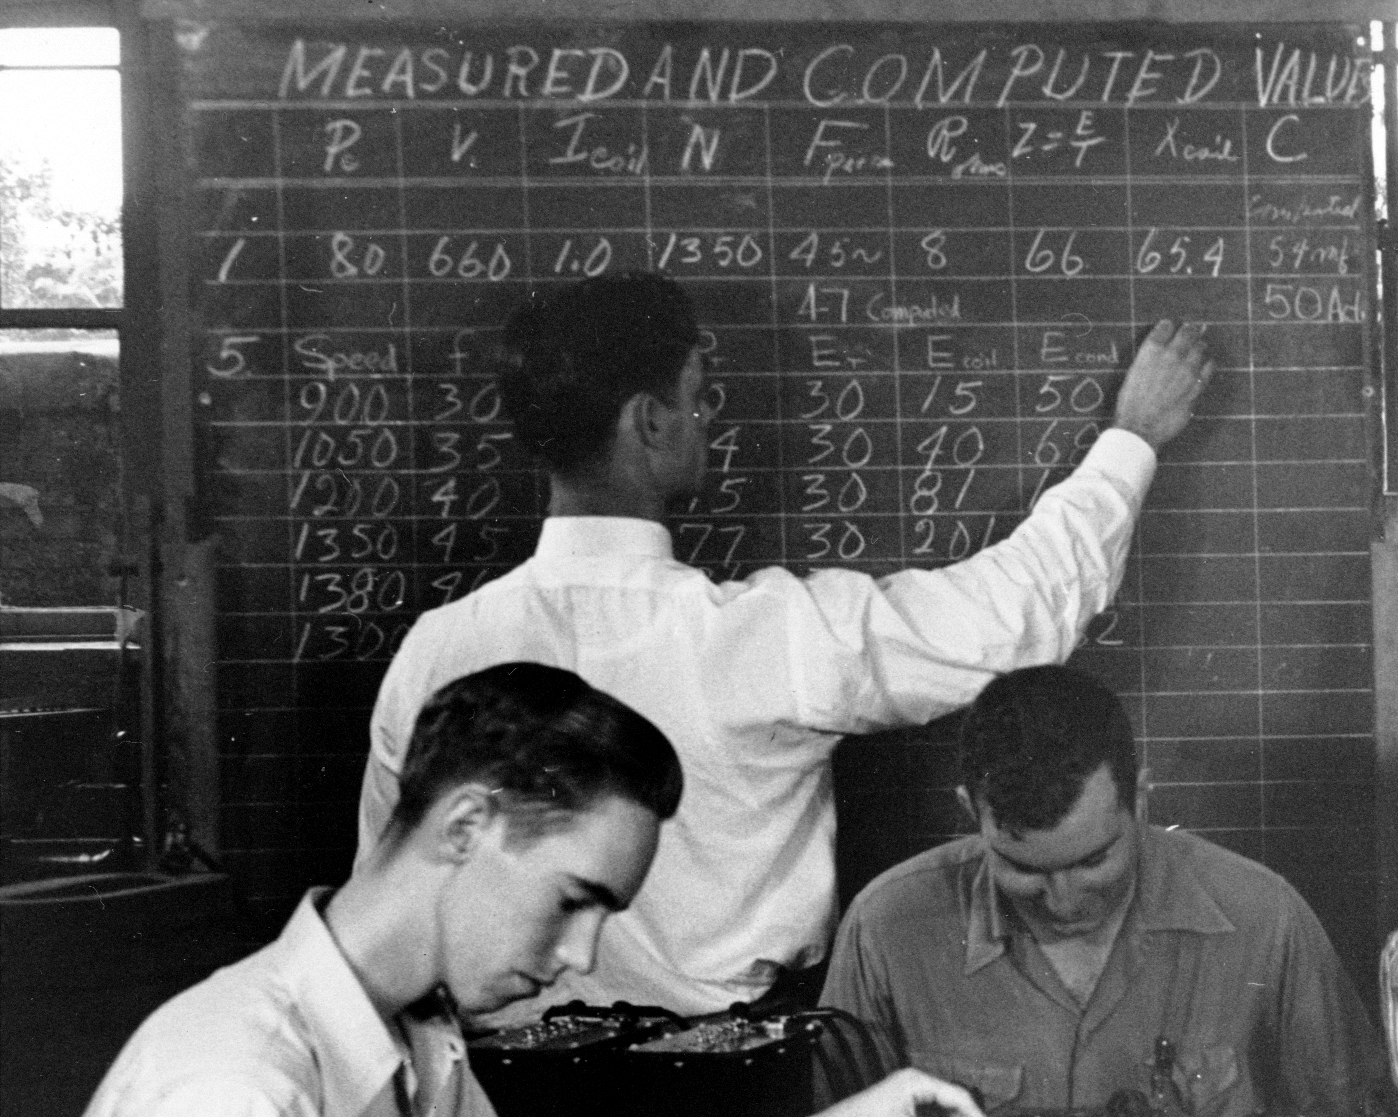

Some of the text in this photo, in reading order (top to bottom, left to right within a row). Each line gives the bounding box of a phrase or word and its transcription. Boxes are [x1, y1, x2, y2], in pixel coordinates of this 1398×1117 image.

[278, 40, 629, 100] MEASURED
[644, 46, 777, 101] AND
[803, 45, 1221, 108] COMPUTED
[682, 123, 721, 170] N
[1266, 114, 1308, 163] C
[218, 238, 246, 283] 1
[331, 232, 385, 278] 80
[429, 236, 511, 282] 660
[554, 238, 613, 278] 1.0
[658, 233, 763, 269] 1350
[920, 229, 948, 270] 8
[1025, 228, 1084, 276] 66
[1137, 228, 1224, 277] 65.4
[798, 283, 850, 323] 47
[1265, 284, 1322, 320] 50
[207, 336, 261, 379] 5
[295, 334, 397, 381] Speed
[301, 376, 1104, 426] 900 30 30 15 50
[294, 428, 399, 469] 1050
[432, 432, 514, 473] 35
[807, 424, 872, 468] 30
[917, 426, 984, 475] 40
[289, 472, 400, 518] 1200
[431, 477, 502, 519] 40
[803, 472, 867, 512] 30
[296, 523, 399, 561] 1350
[804, 520, 866, 559] 30
[300, 567, 405, 614] 1380
